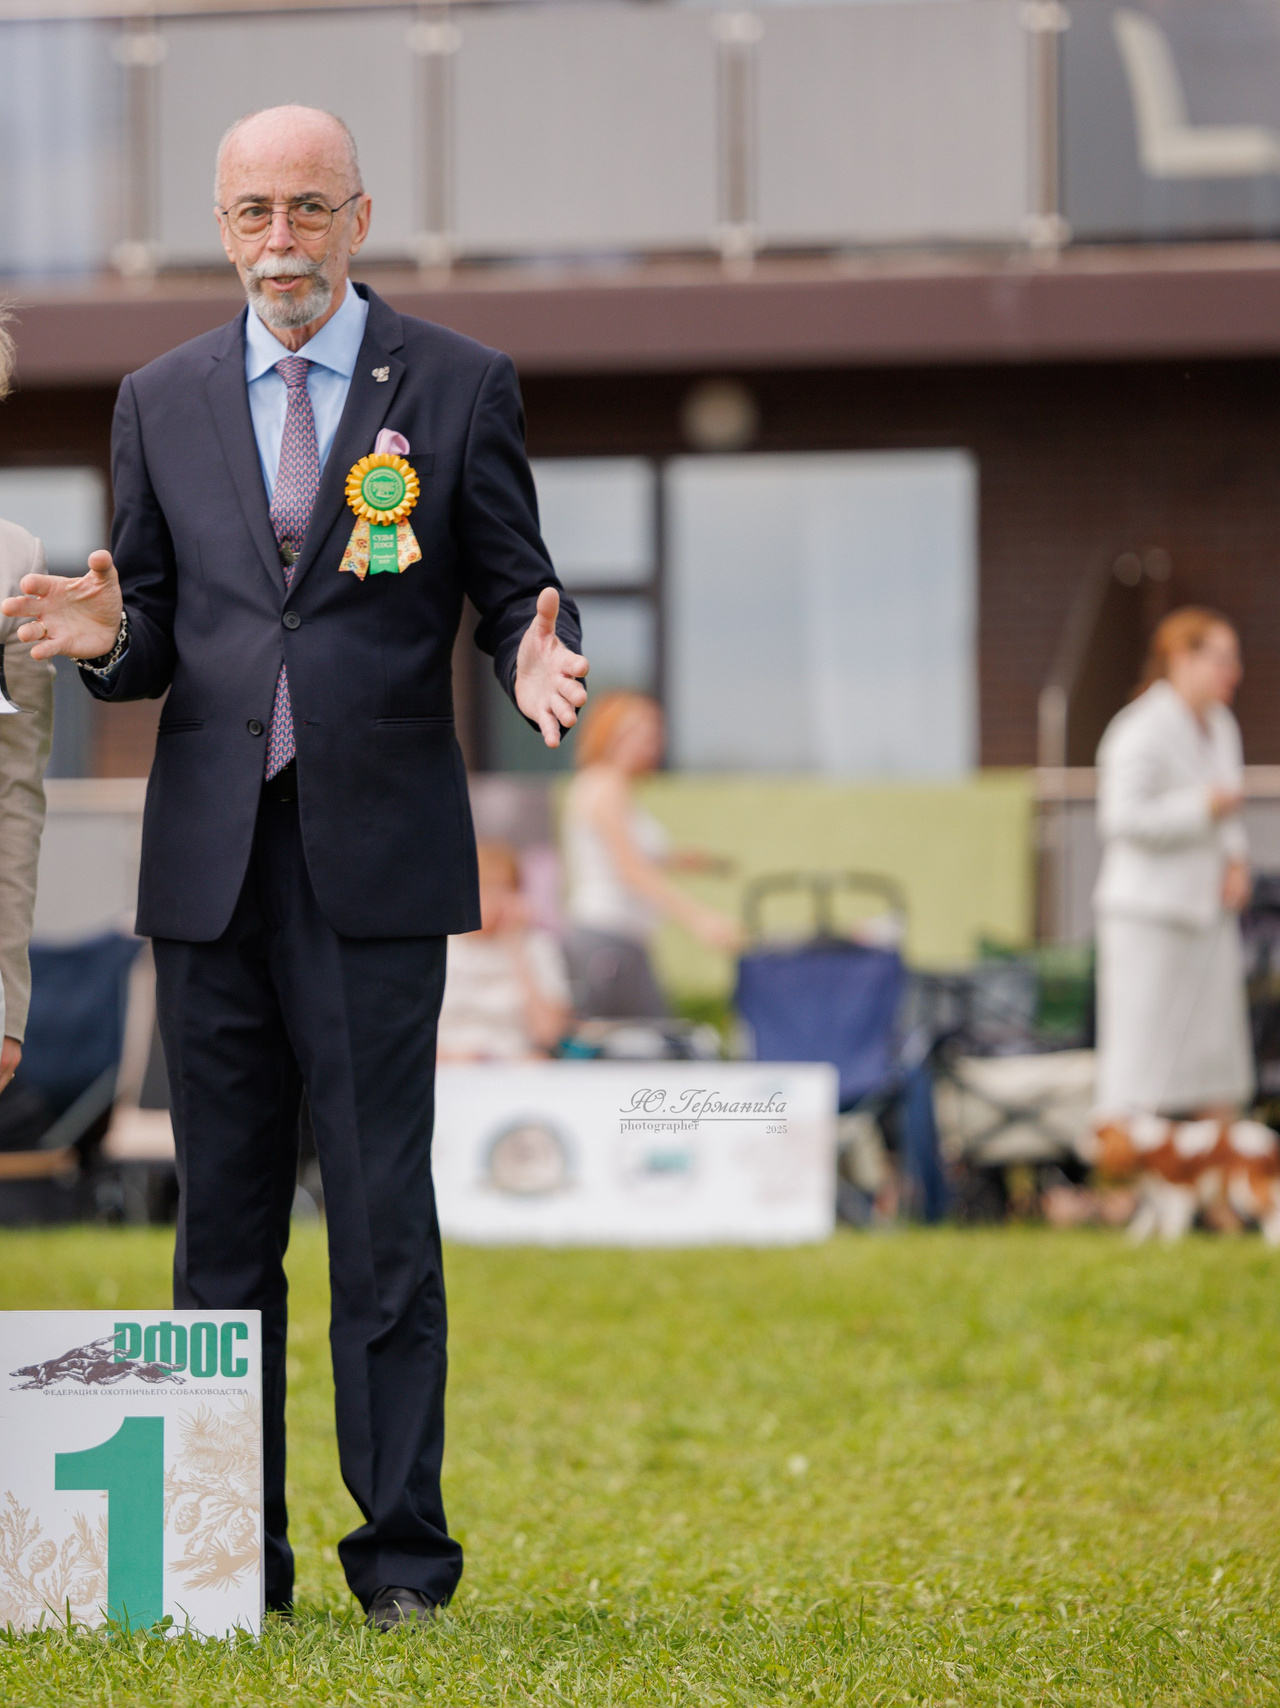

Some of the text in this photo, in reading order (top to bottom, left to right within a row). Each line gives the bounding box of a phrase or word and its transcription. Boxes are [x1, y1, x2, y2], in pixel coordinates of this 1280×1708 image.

[113, 1320, 249, 1378] РФОС
[42, 1388, 249, 1396] ФЕДЕРАЦИЯ ОХОТНИЧЬЕГО СОБАКОВОДСТВА
[55, 1416, 165, 1639] 1
